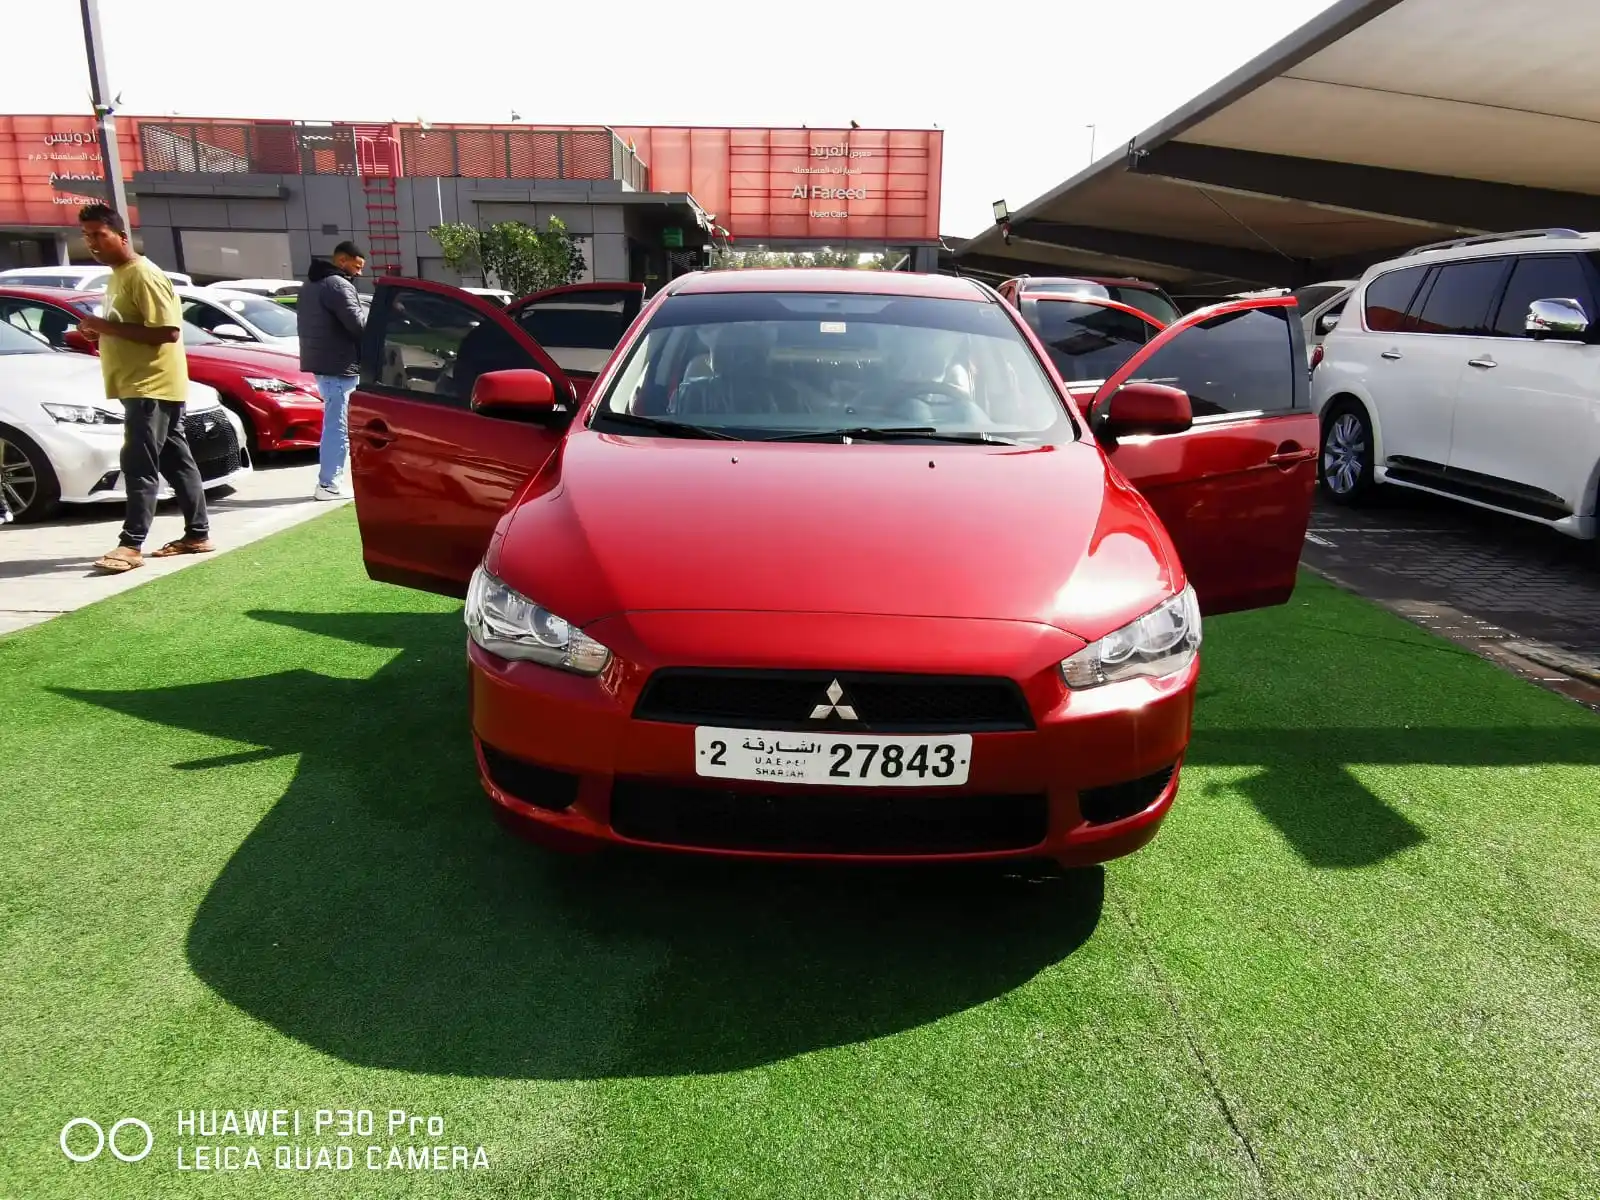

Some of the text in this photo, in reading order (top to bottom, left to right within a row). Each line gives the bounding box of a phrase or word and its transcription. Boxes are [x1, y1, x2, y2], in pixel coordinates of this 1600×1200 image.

[52, 195, 72, 205] Used
[791, 185, 867, 201] Al Fareed
[810, 210, 848, 219] Used Cars
[710, 740, 727, 766] 2
[742, 737, 822, 755] الشارقة
[828, 743, 956, 778] 27843
